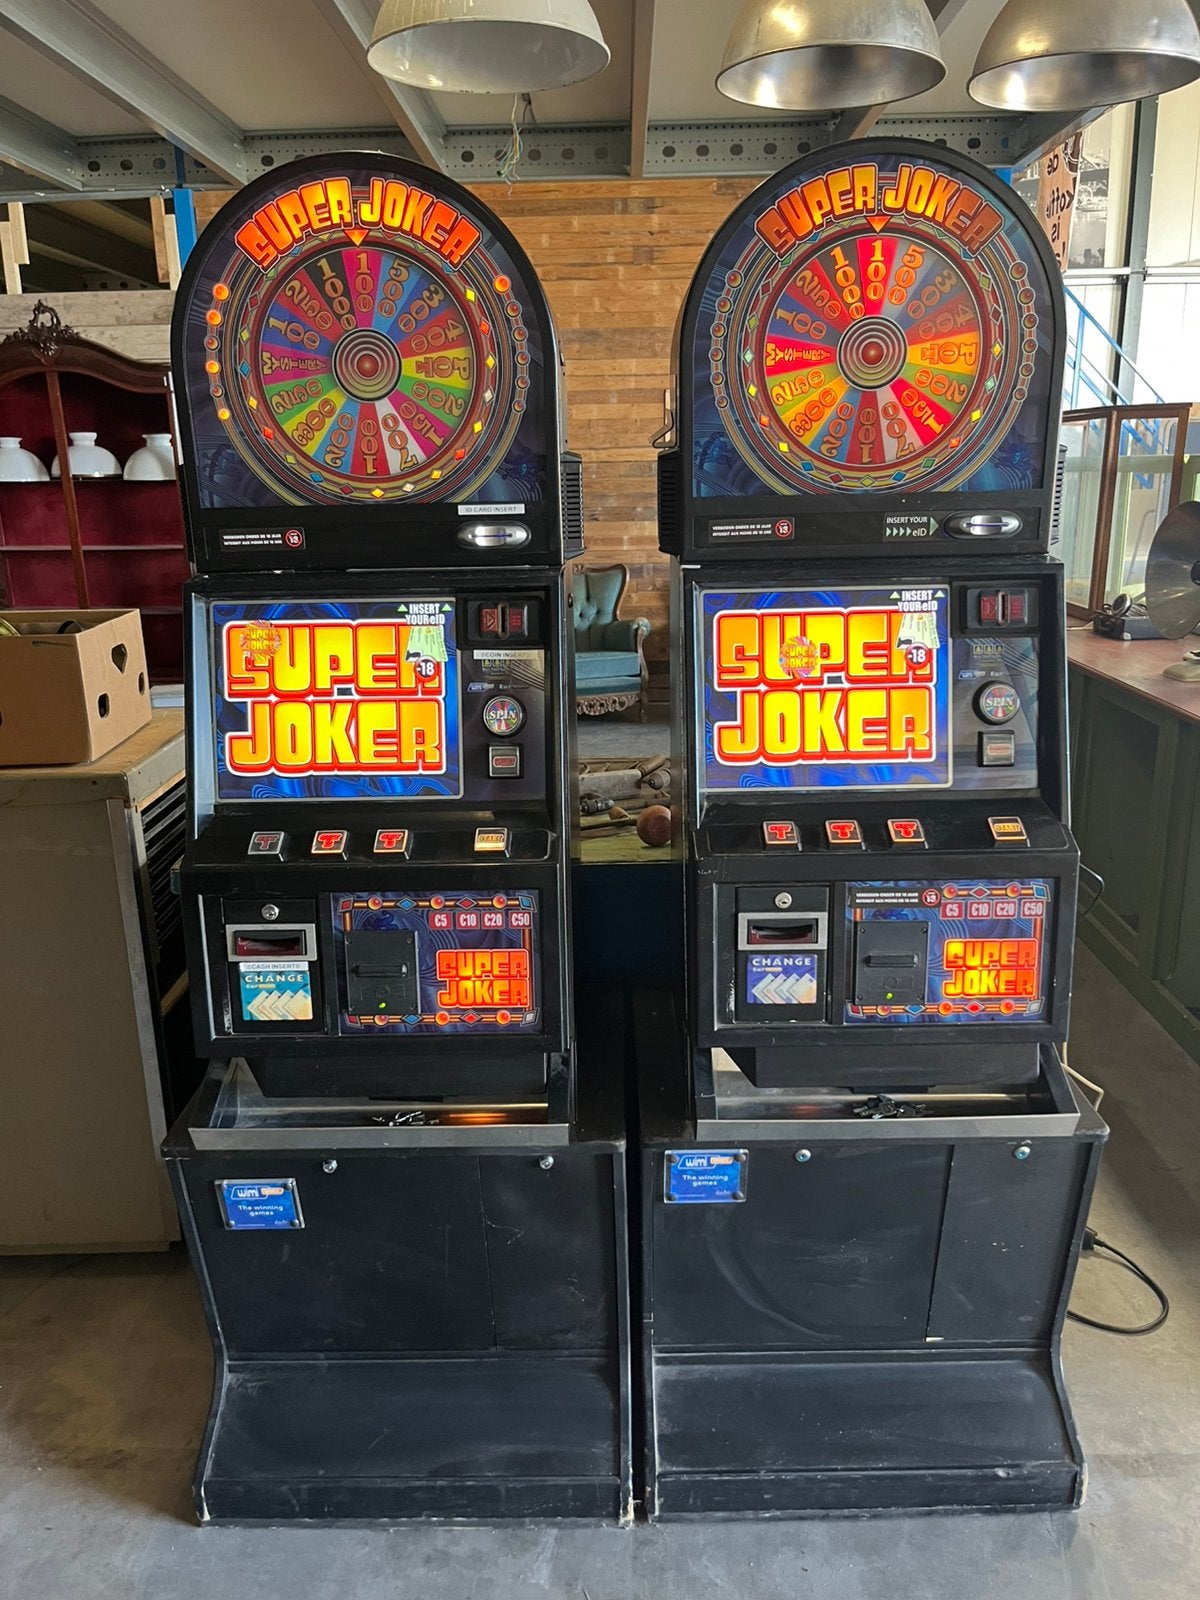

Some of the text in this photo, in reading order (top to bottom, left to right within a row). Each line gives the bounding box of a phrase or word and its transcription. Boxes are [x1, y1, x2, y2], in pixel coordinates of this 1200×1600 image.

[235, 177, 482, 273] SUPER JOKER
[754, 163, 1004, 261] SUPER JOKER
[354, 252, 375, 313] 100
[378, 259, 411, 318] 500
[830, 246, 865, 319] 1000
[866, 240, 887, 299] 100
[888, 244, 927, 305] 500
[285, 279, 334, 331] 250
[317, 258, 357, 331] 1000
[398, 283, 445, 333] 300
[795, 269, 841, 320] 250
[908, 269, 957, 320] 300
[269, 316, 320, 350] 100
[410, 319, 465, 353] 400
[776, 308, 827, 340] 100
[918, 303, 976, 340] 400
[262, 352, 327, 376] MYSTERY
[415, 356, 470, 380] POT
[765, 343, 831, 367] MYSTERY
[921, 343, 978, 366] POT
[271, 378, 323, 414] 250
[412, 382, 465, 418] 200
[771, 368, 825, 406] 250
[915, 368, 968, 403] 200
[291, 398, 337, 446] 300
[400, 401, 444, 447] 150
[789, 388, 837, 437] 300
[819, 402, 854, 457] 200
[881, 401, 916, 459] 700
[901, 388, 944, 435] 150
[324, 413, 355, 467] 200
[360, 419, 379, 475] 100
[381, 412, 419, 471] 700
[857, 407, 877, 464] 100
[912, 527, 927, 536] eID
[409, 603, 440, 614] INSERT
[898, 600, 938, 612] YOUR eID
[902, 590, 933, 601] INSERT
[405, 614, 445, 625] YOUR eID
[226, 622, 445, 698] SUPER
[716, 610, 934, 687] SUPER
[489, 709, 516, 720] SPIN
[716, 687, 934, 761] JOKER
[986, 697, 1014, 708] SPIN
[226, 699, 444, 773] JOKER
[437, 950, 528, 979] SUPER
[752, 958, 811, 966] CHANGE
[945, 940, 1037, 969] SUPER
[438, 979, 529, 1007] JOKER
[944, 969, 1036, 997] JOKER
